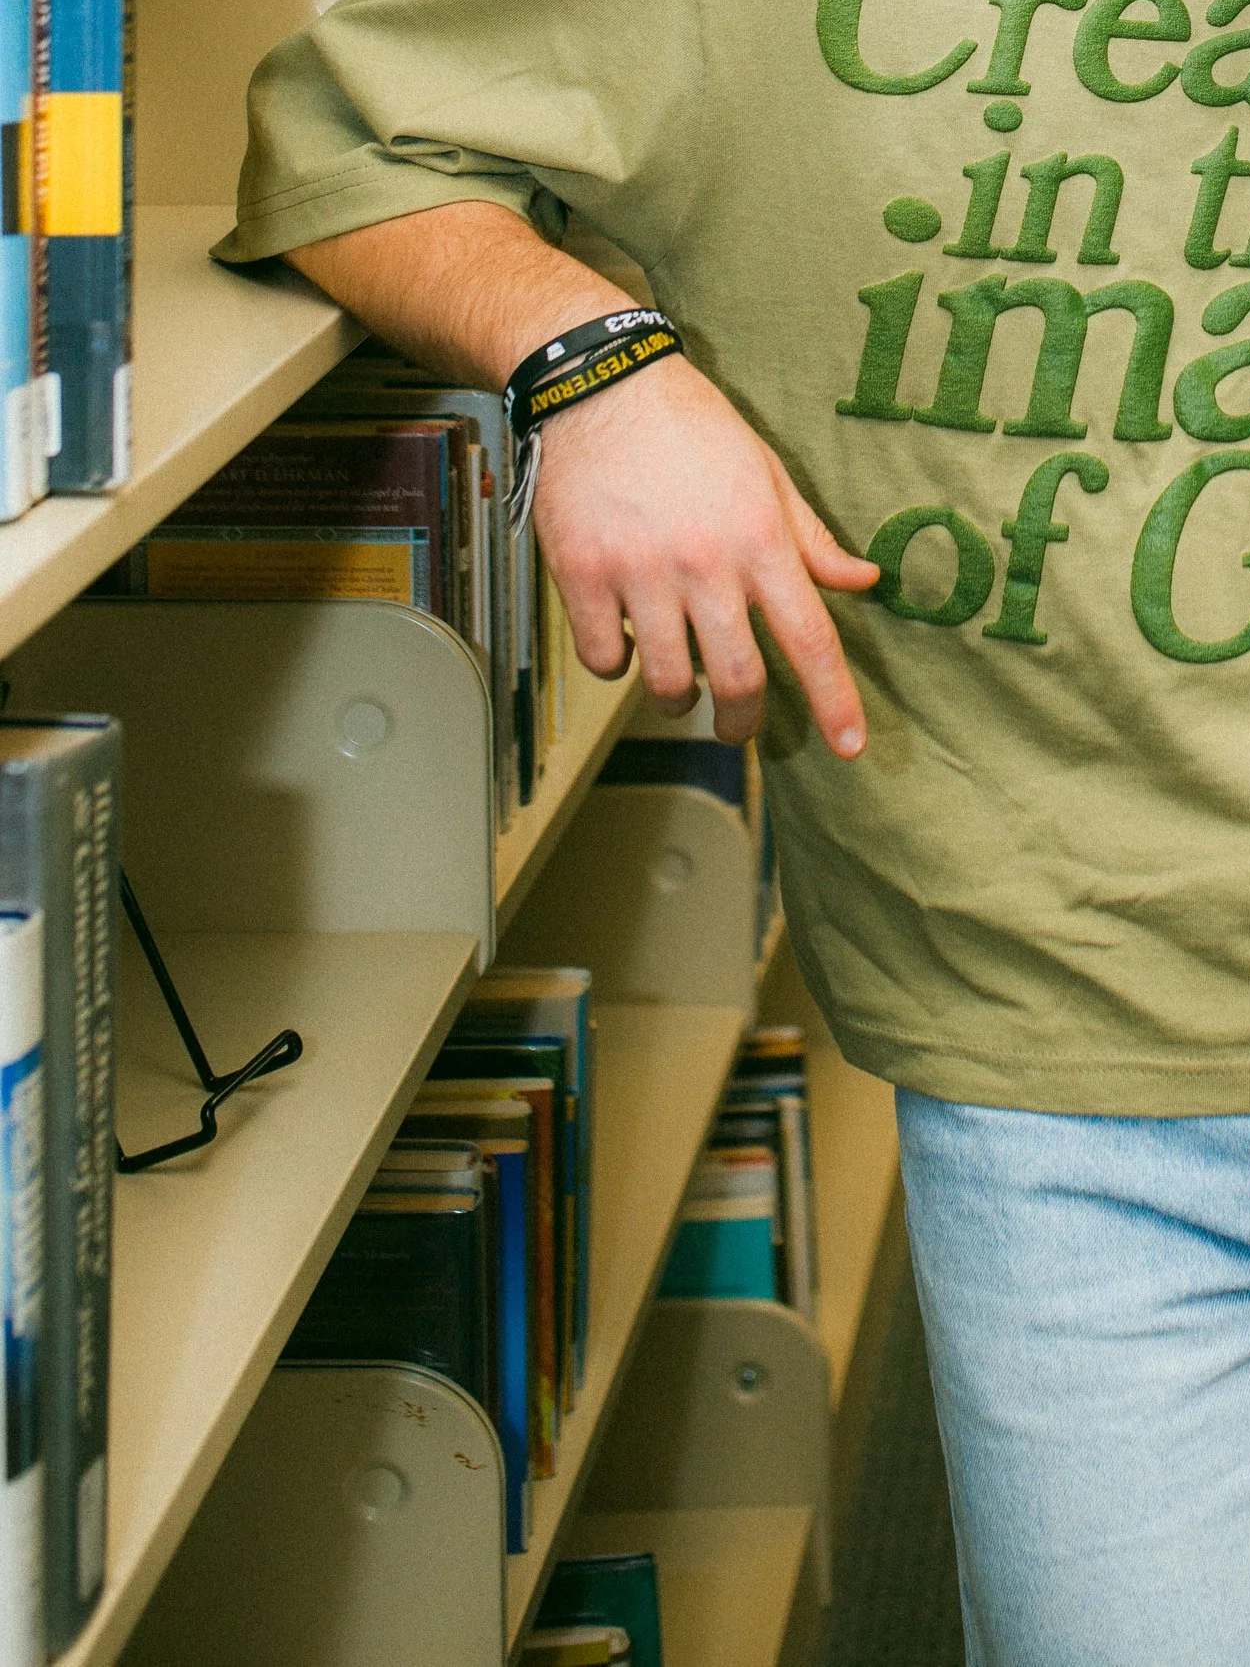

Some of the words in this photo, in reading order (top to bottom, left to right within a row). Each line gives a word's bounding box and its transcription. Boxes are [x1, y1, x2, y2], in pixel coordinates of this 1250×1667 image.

[942, 99, 1124, 266] in
[530, 350, 634, 416] YESTERDAY
[866, 450, 1110, 646] of
